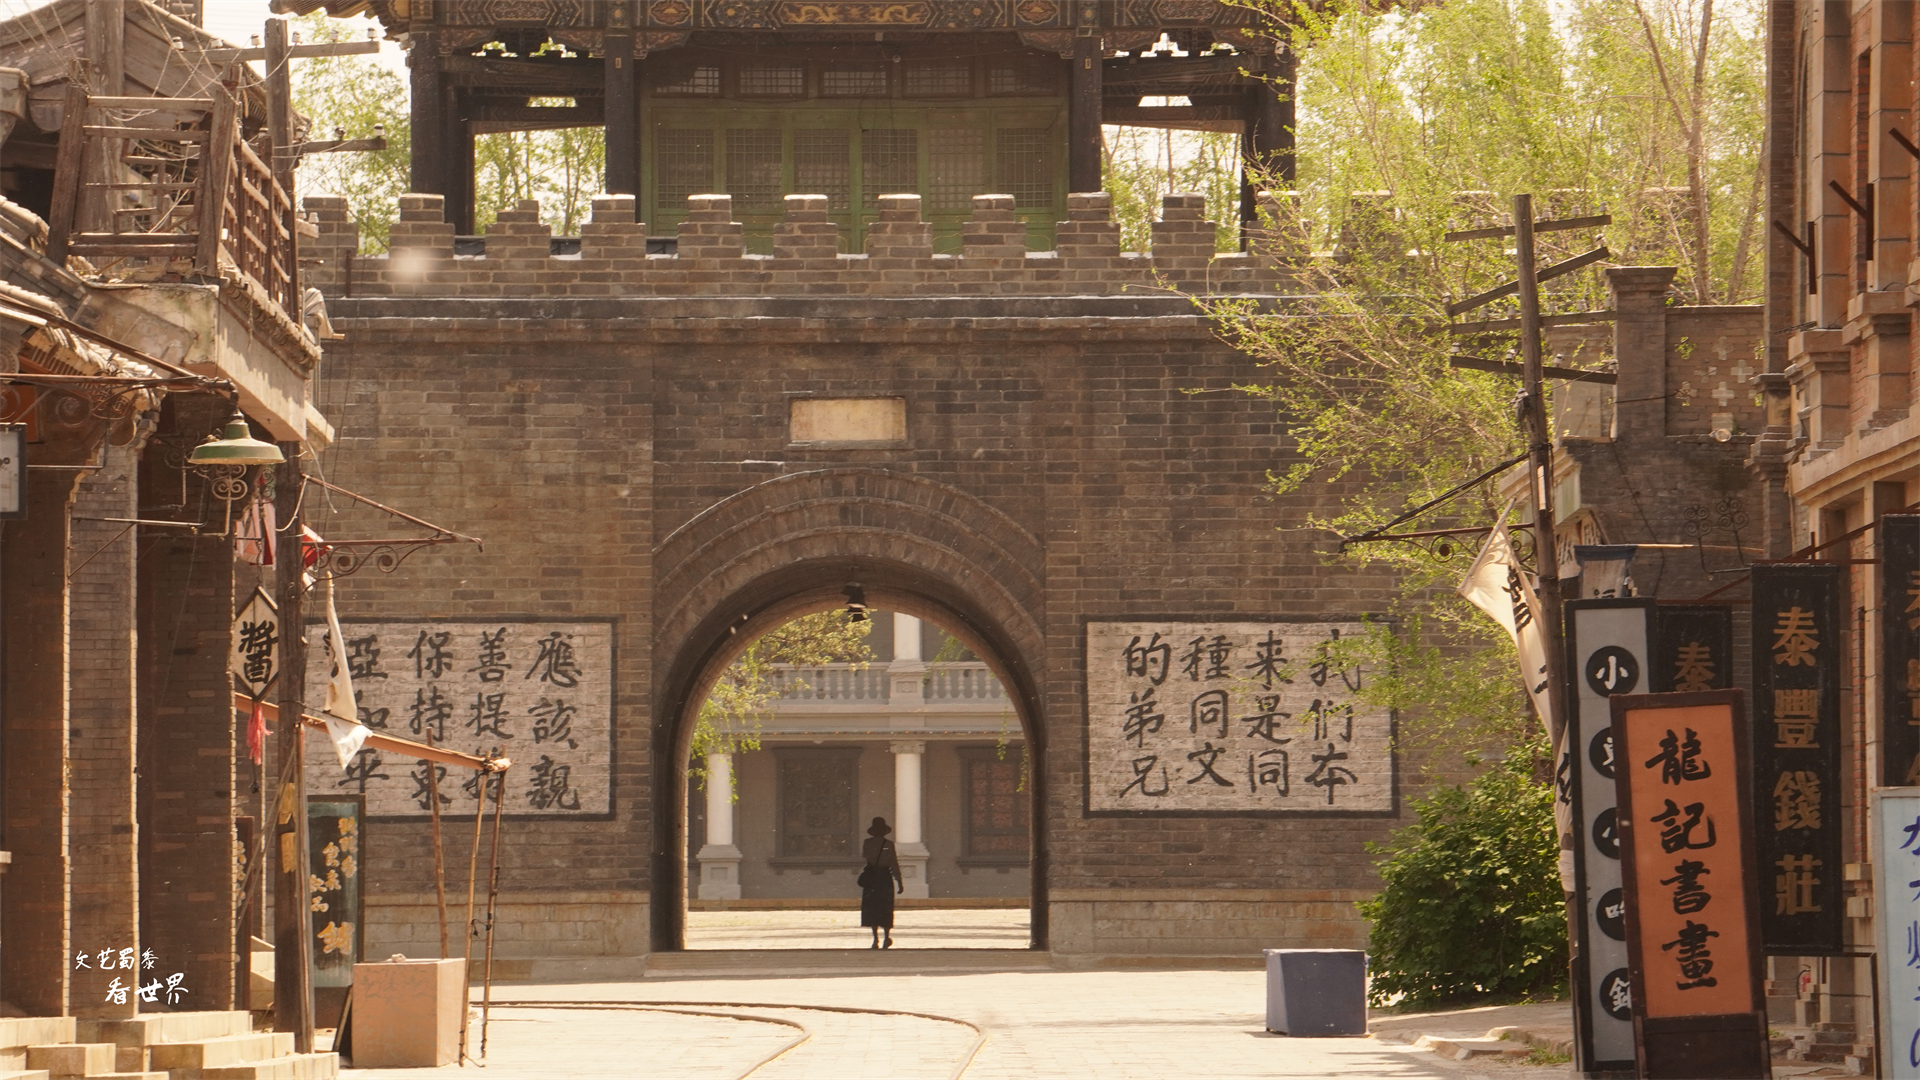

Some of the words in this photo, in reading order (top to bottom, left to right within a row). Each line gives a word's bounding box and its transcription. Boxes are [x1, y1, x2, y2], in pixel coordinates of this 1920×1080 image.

[525, 631, 582, 811] 應該親
[1119, 632, 1171, 798] 的弟兄
[1180, 635, 1234, 787] 種同文
[1771, 606, 1823, 915] 泰豐錢莊
[1644, 727, 1719, 991] 龍記書畫
